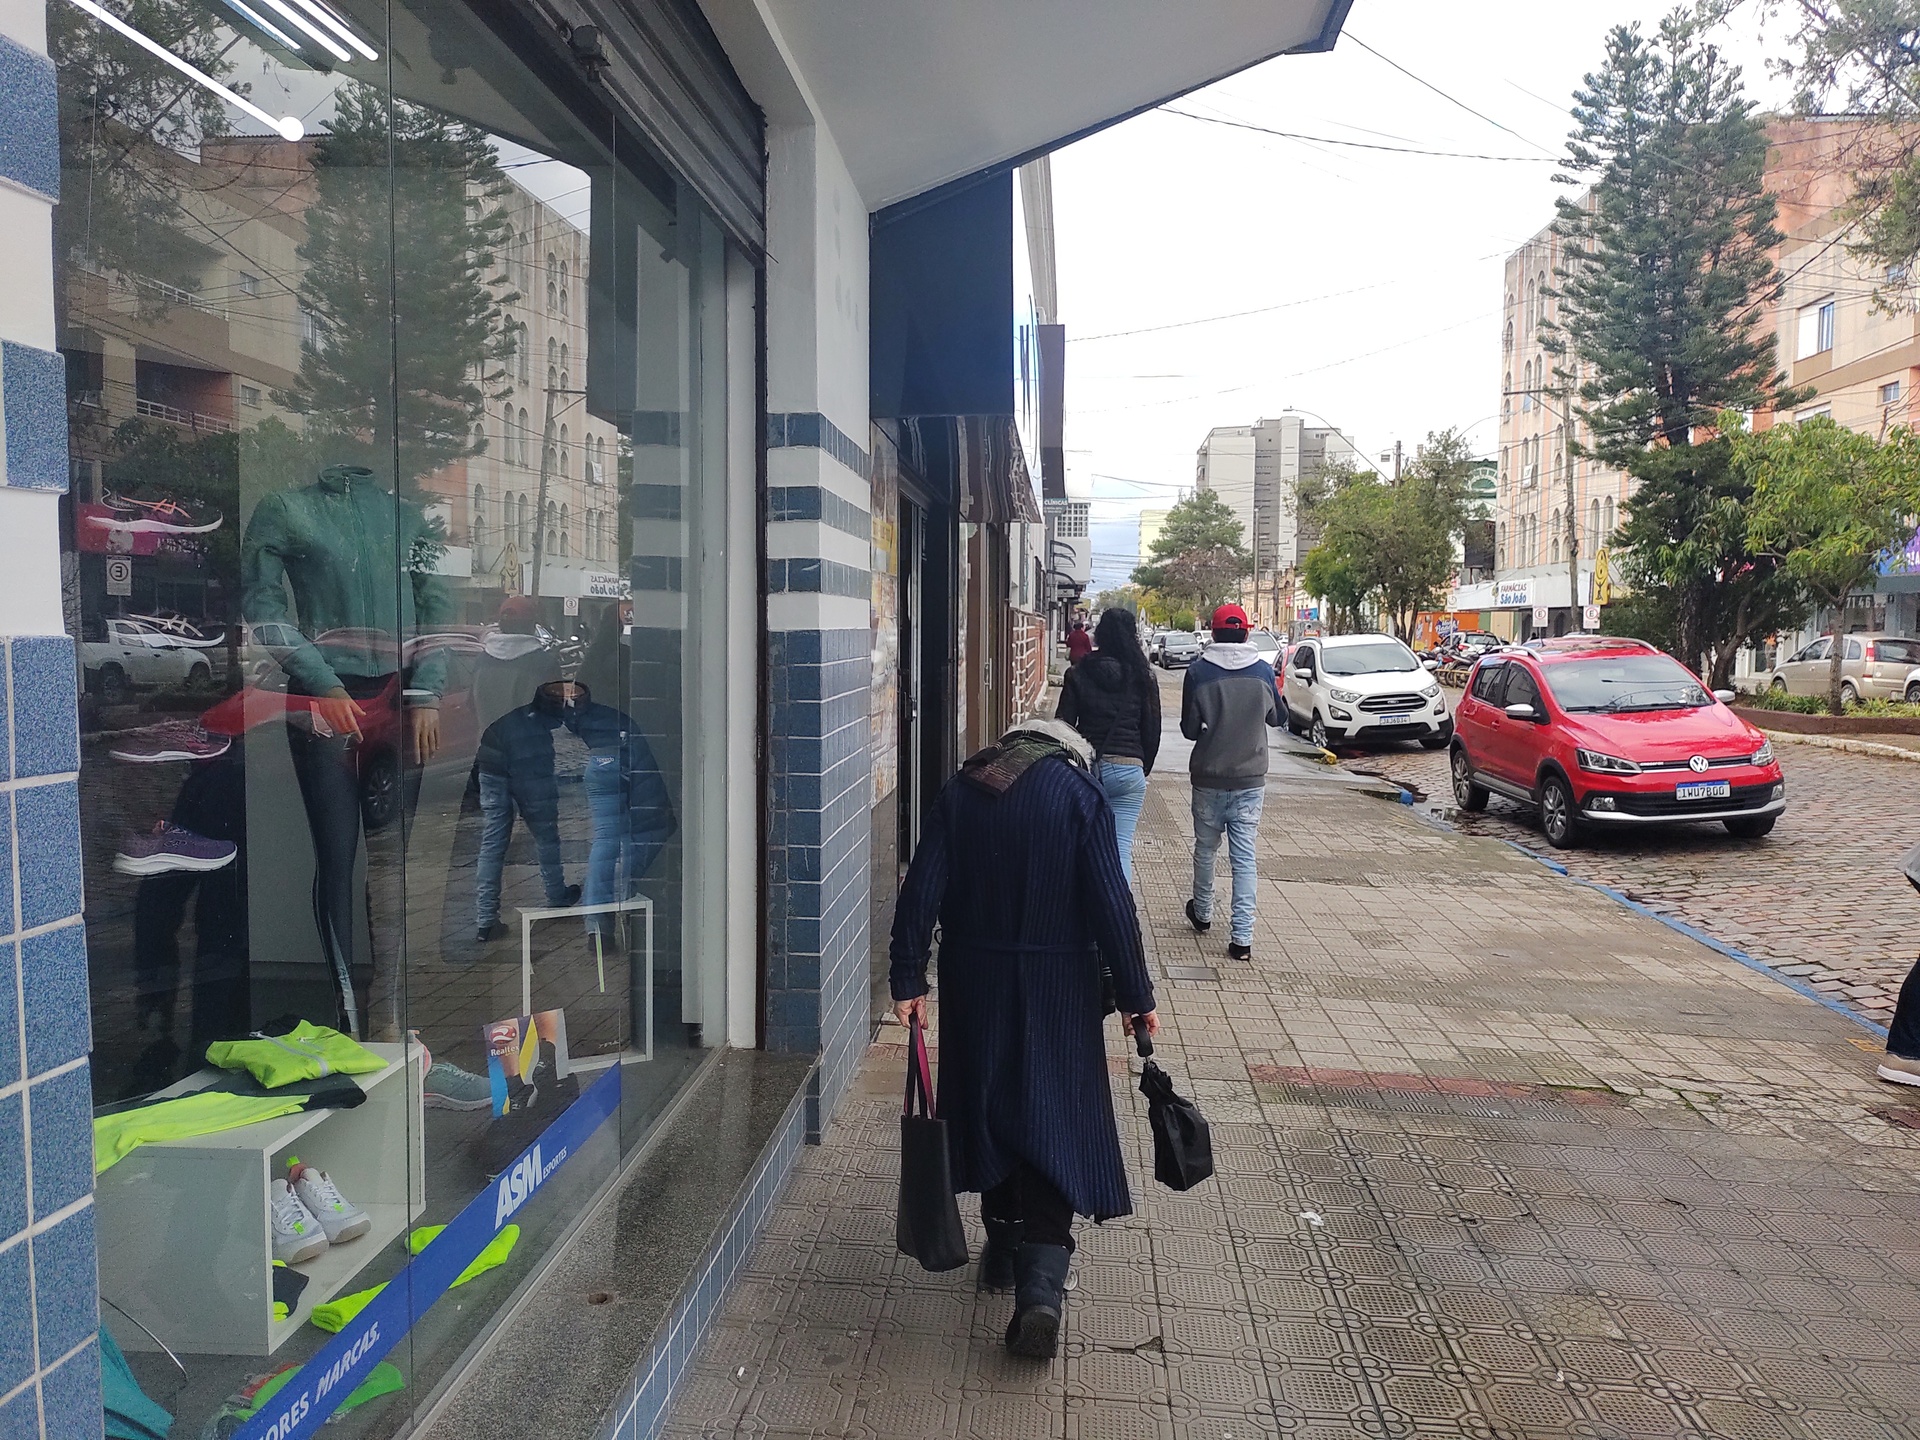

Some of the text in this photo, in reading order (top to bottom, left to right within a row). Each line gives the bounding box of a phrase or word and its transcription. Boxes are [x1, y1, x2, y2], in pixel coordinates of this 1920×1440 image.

[1500, 592, 1527, 604] São João
[1501, 583, 1527, 592] FARMÁCIAS
[495, 1143, 567, 1231] ASM ESPORTES
[314, 1321, 381, 1406] MARCAS.
